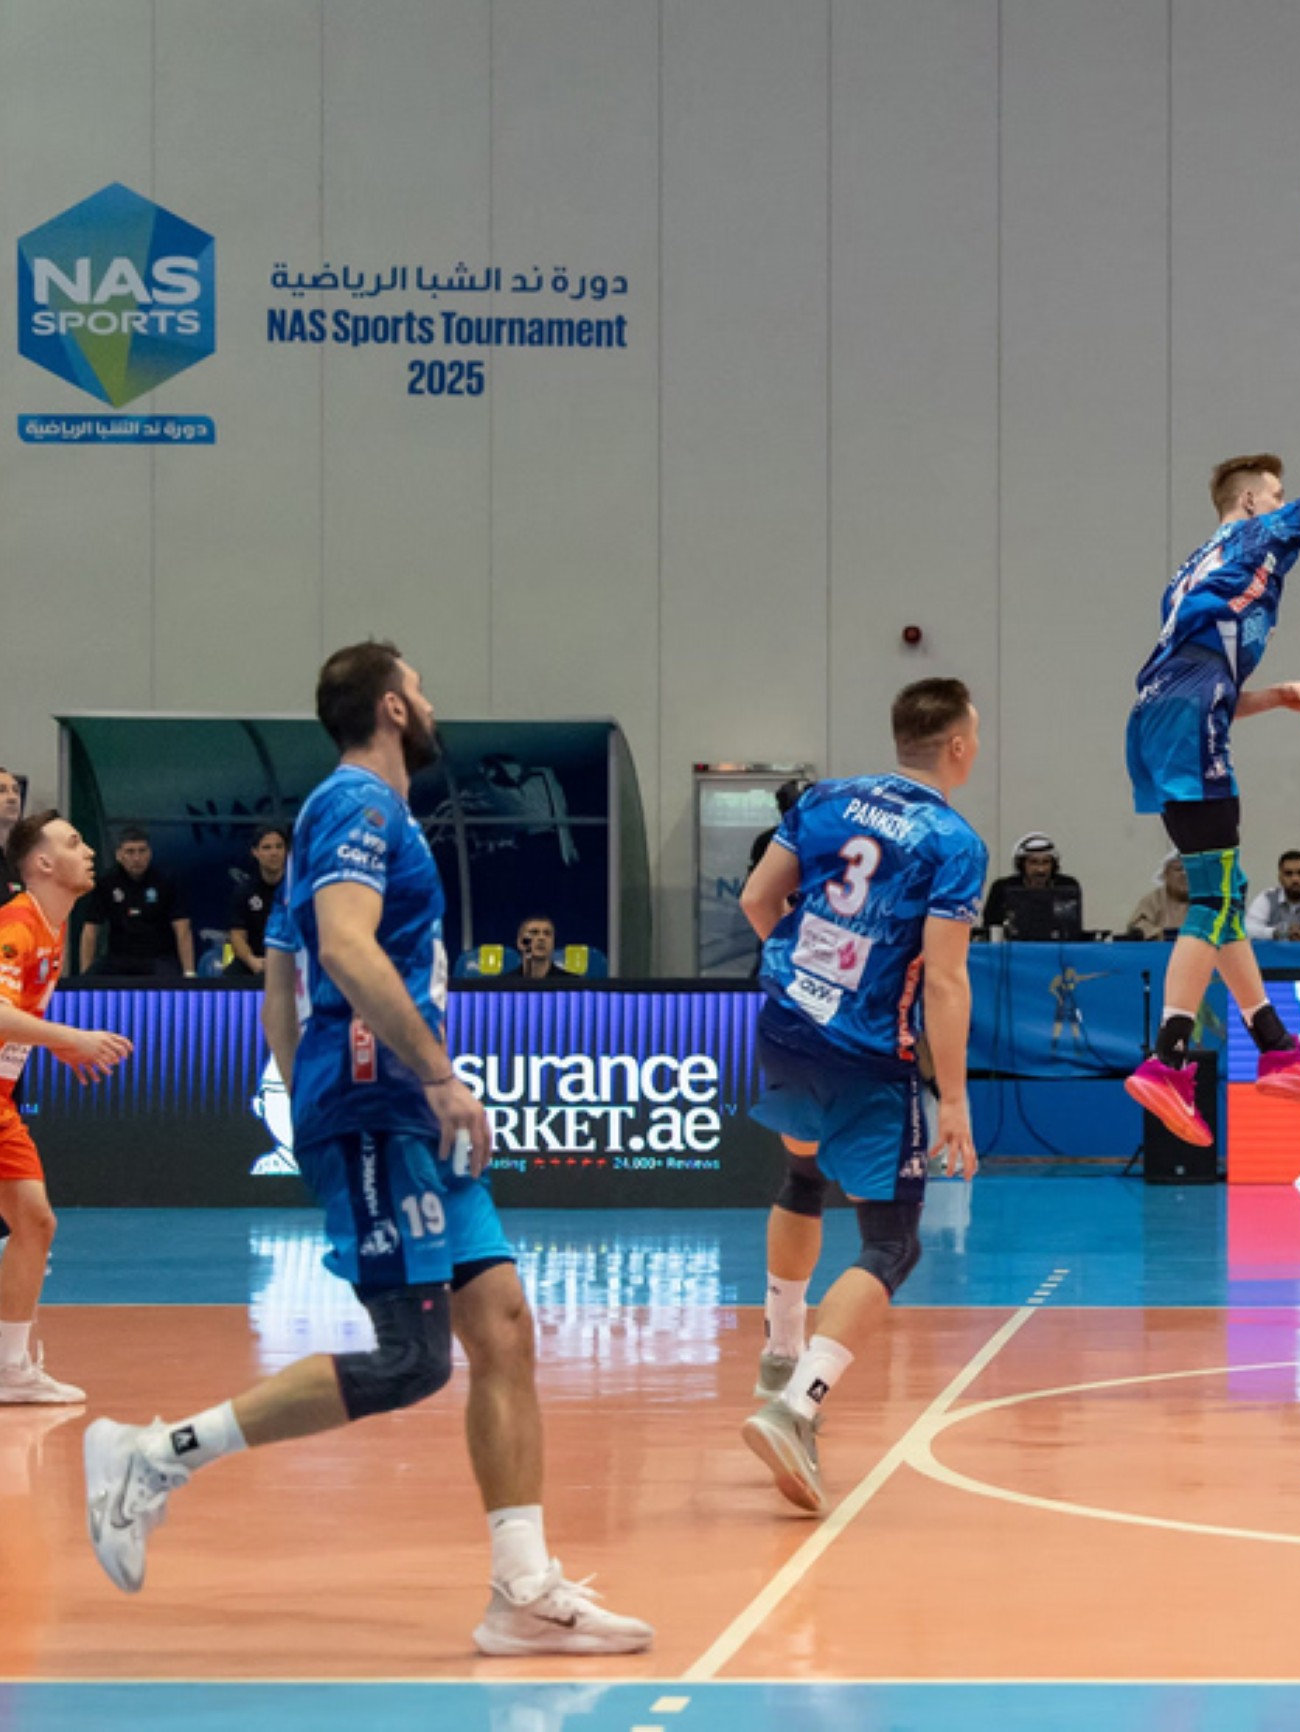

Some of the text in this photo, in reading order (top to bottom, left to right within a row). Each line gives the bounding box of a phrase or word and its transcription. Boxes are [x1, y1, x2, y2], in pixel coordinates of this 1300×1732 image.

[33, 257, 202, 305] NAS
[270, 262, 629, 300] دورة ند الشبا الرياضية
[32, 310, 201, 336] SPORTS
[266, 309, 628, 349] NAS Sports Tournament
[407, 360, 486, 396] 2025
[825, 836, 881, 917] 3
[452, 1053, 718, 1103] surance
[483, 1105, 721, 1152] RKET.ae
[489, 1157, 527, 1174] ating
[402, 1191, 446, 1239] 19
